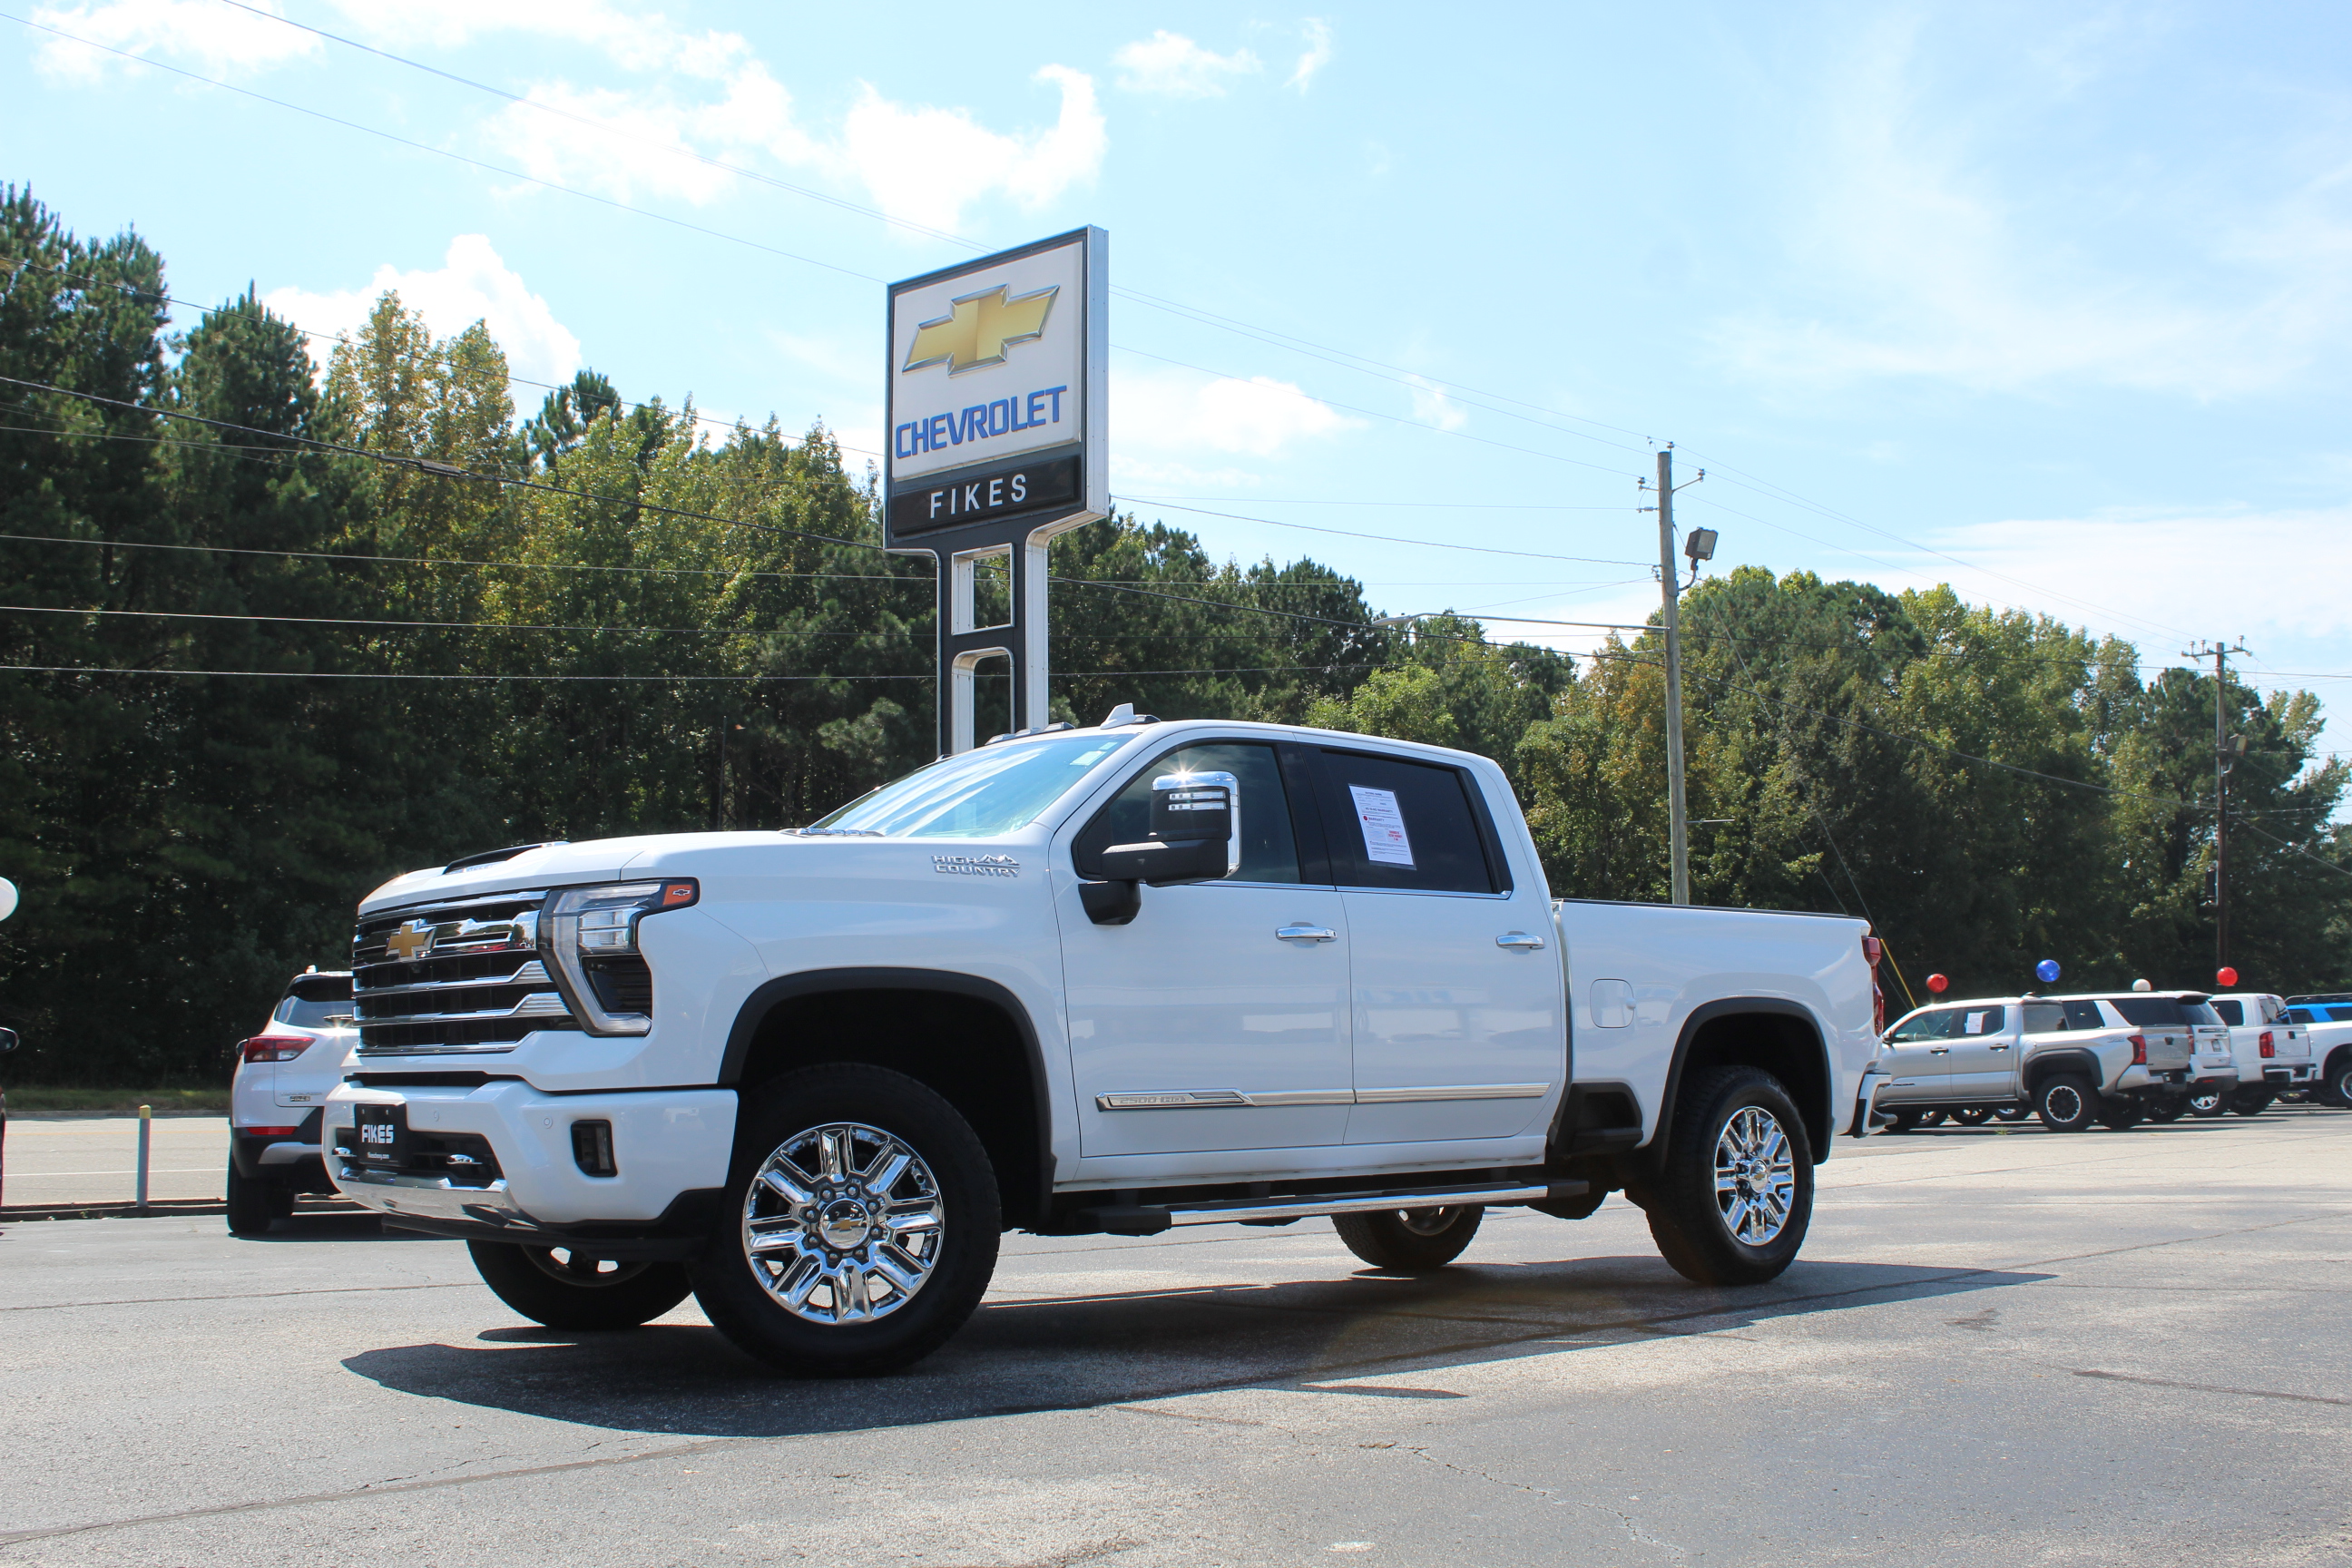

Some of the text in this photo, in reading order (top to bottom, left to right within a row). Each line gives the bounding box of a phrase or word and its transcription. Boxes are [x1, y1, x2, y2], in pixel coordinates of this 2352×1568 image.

[896, 385, 1067, 459] CHEVROLET
[930, 474, 1026, 519] FIKES
[931, 855, 977, 865] HIGH
[935, 864, 1020, 877] COUNTRY
[1120, 1096, 1157, 1104] 2500
[361, 1124, 394, 1143] FIKES
